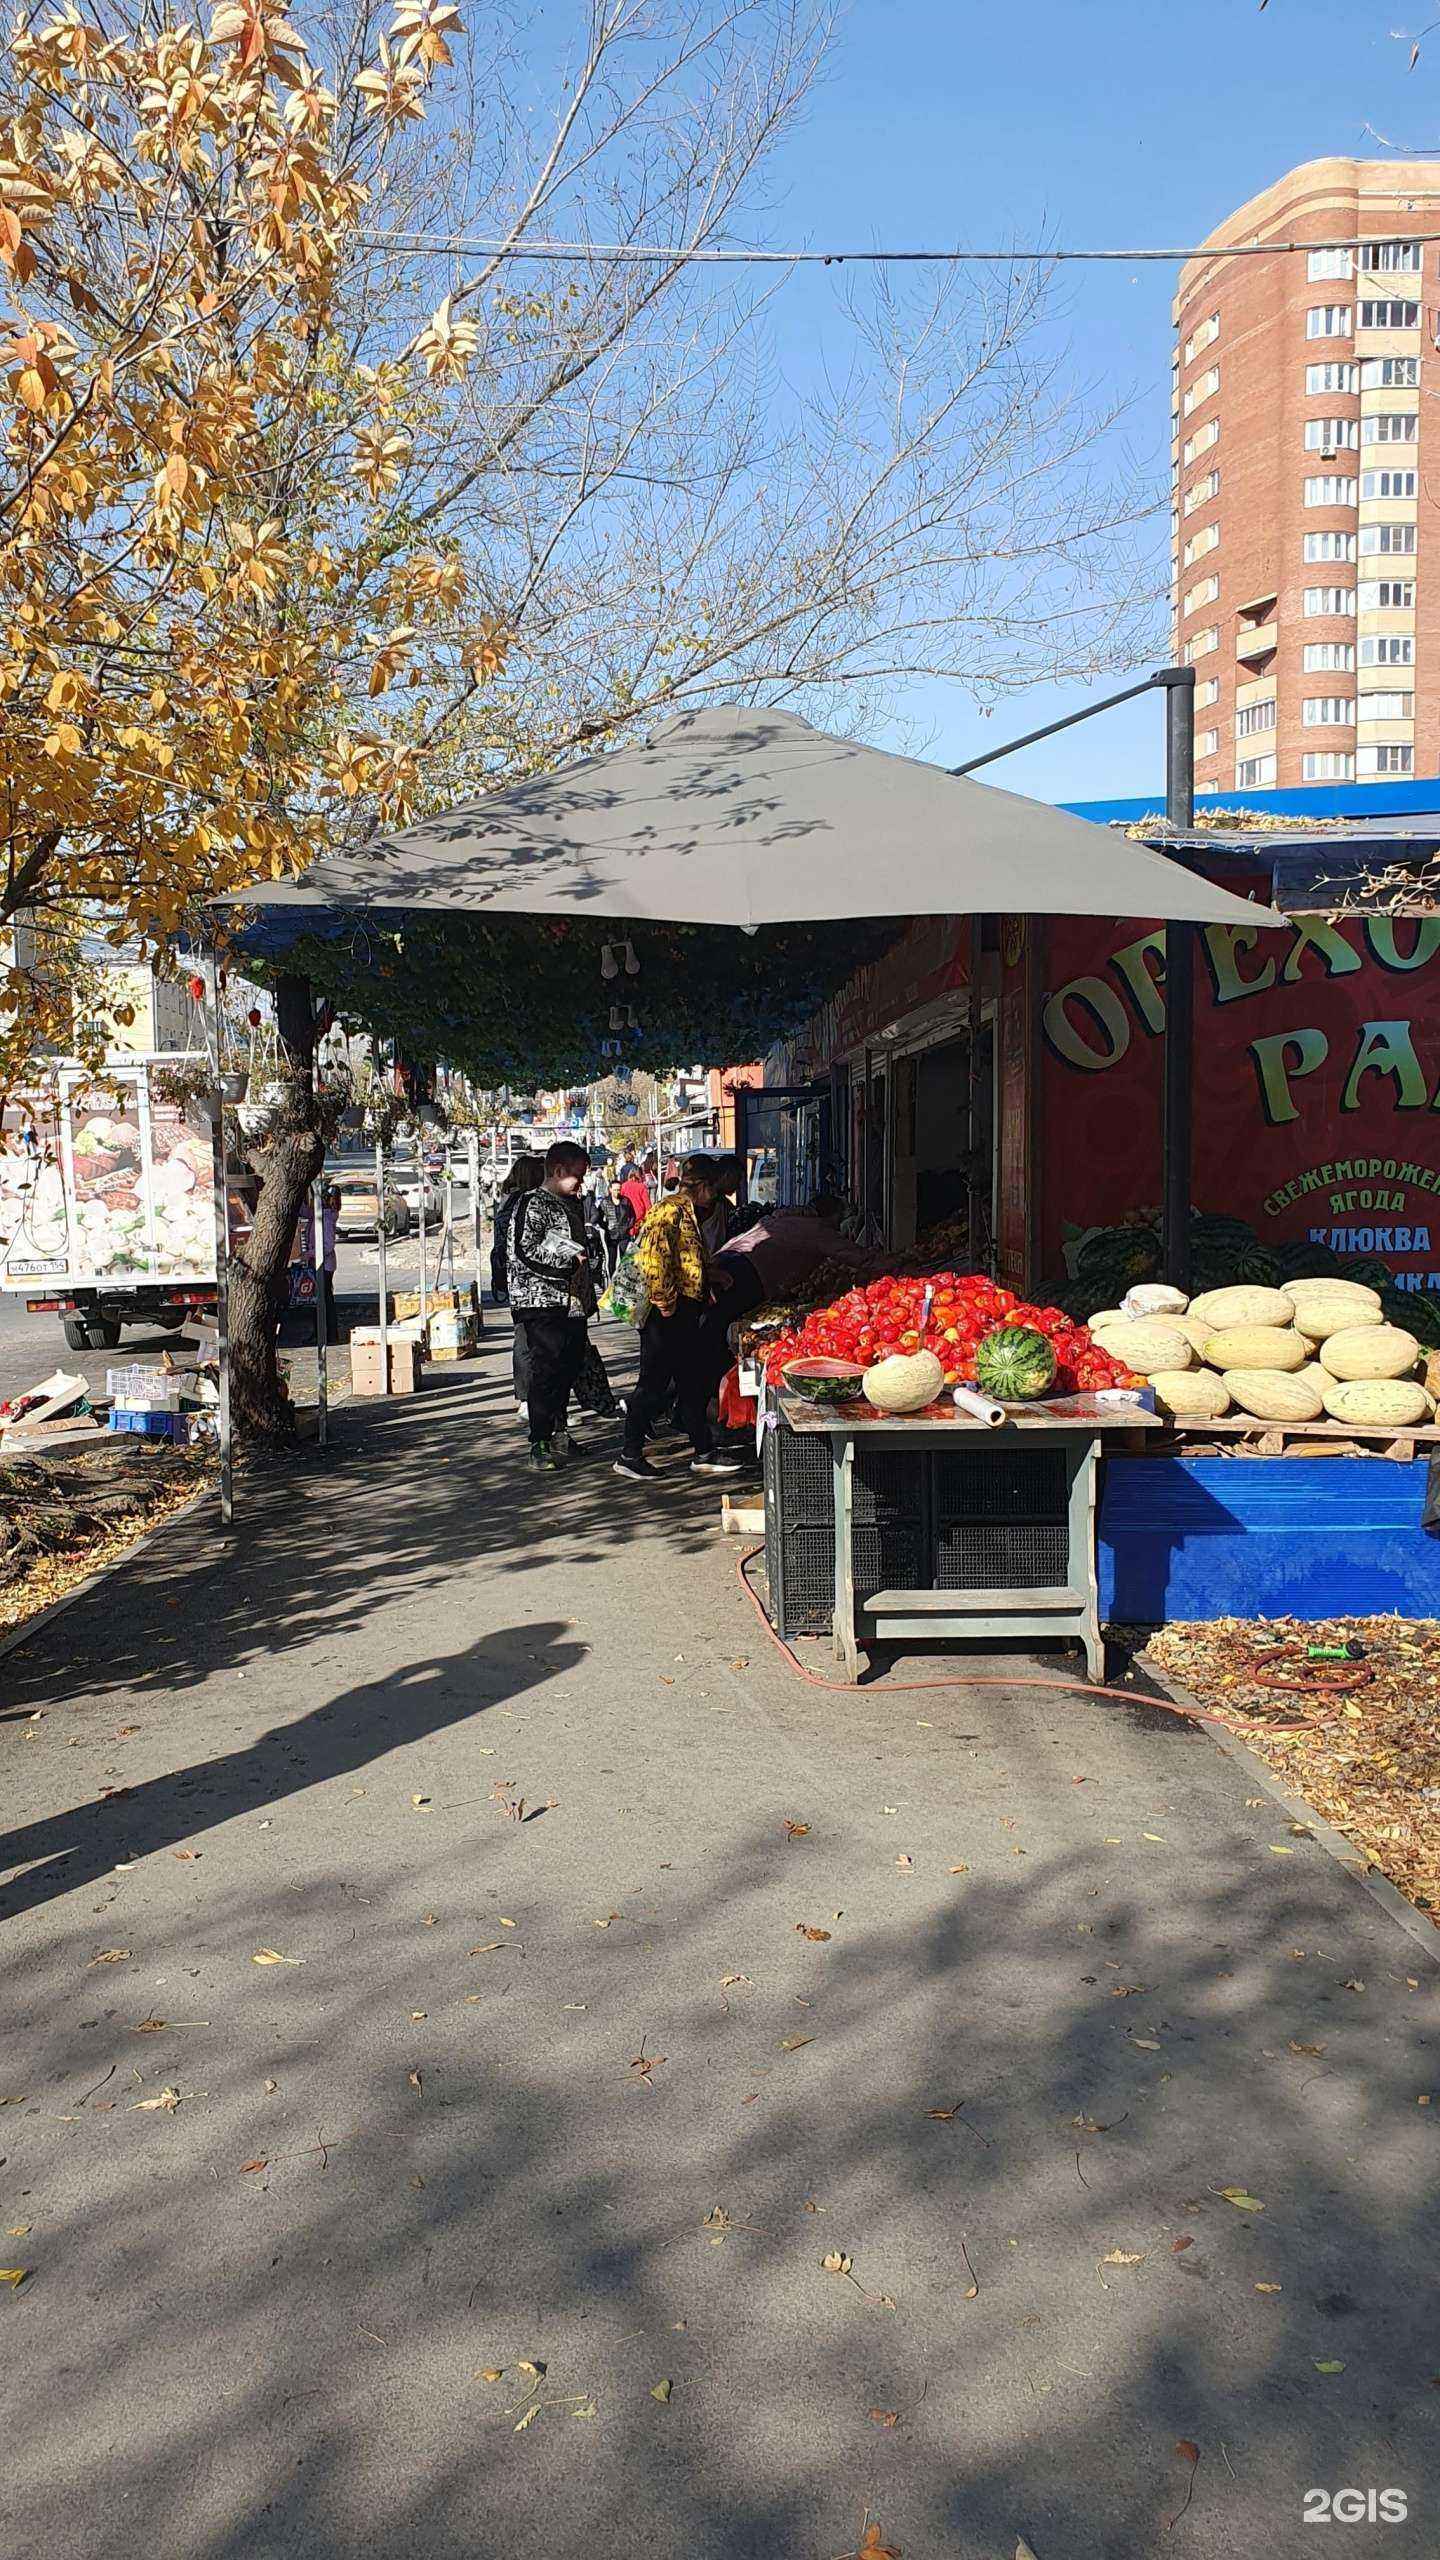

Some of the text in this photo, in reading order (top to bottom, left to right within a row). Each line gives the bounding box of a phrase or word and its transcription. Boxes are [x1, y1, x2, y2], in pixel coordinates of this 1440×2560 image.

[1248, 1020, 1440, 1126] РА
[1329, 1189, 1406, 1215] ЯГОДА
[1308, 1226, 1431, 1252] КЛЮКВА
